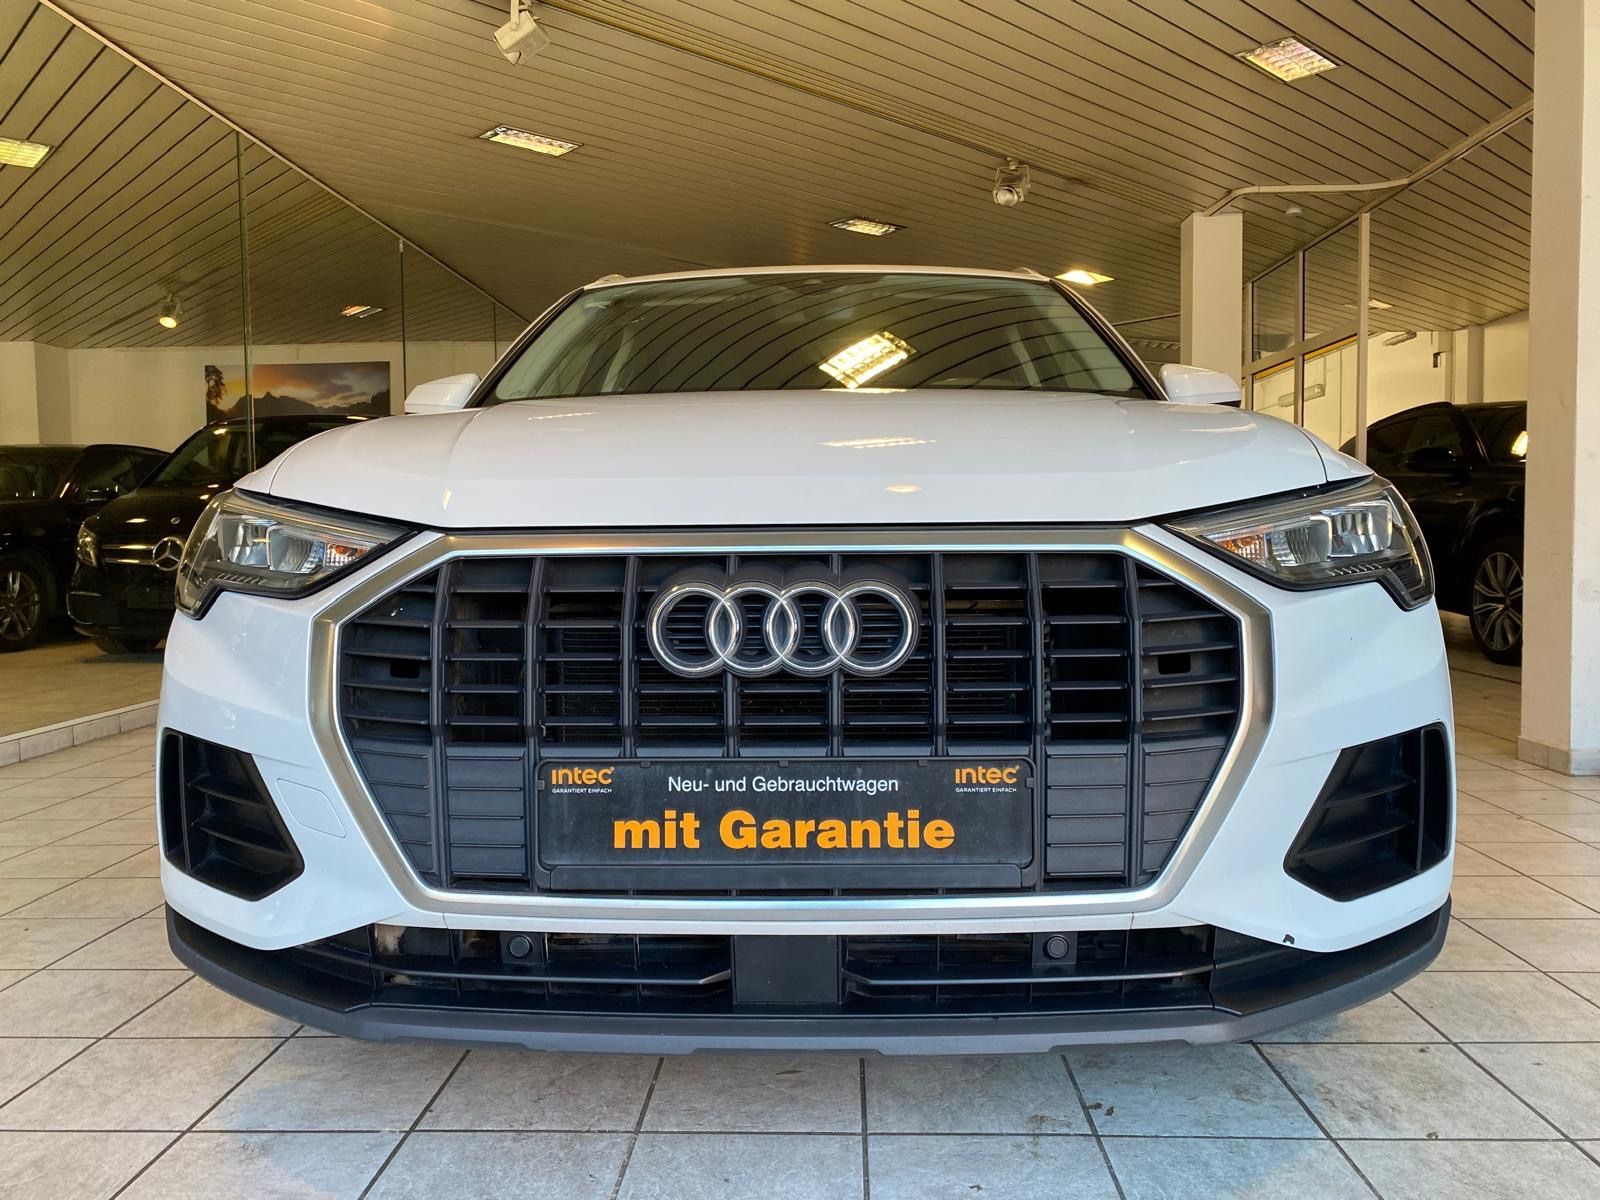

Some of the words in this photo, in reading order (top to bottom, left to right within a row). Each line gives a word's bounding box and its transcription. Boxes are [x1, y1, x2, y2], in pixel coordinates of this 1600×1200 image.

[668, 775, 710, 792] Neu-
[714, 775, 747, 792] und
[751, 775, 899, 797] Gebrauchtwagen
[613, 809, 701, 849] mit
[719, 809, 956, 850] Garantie
